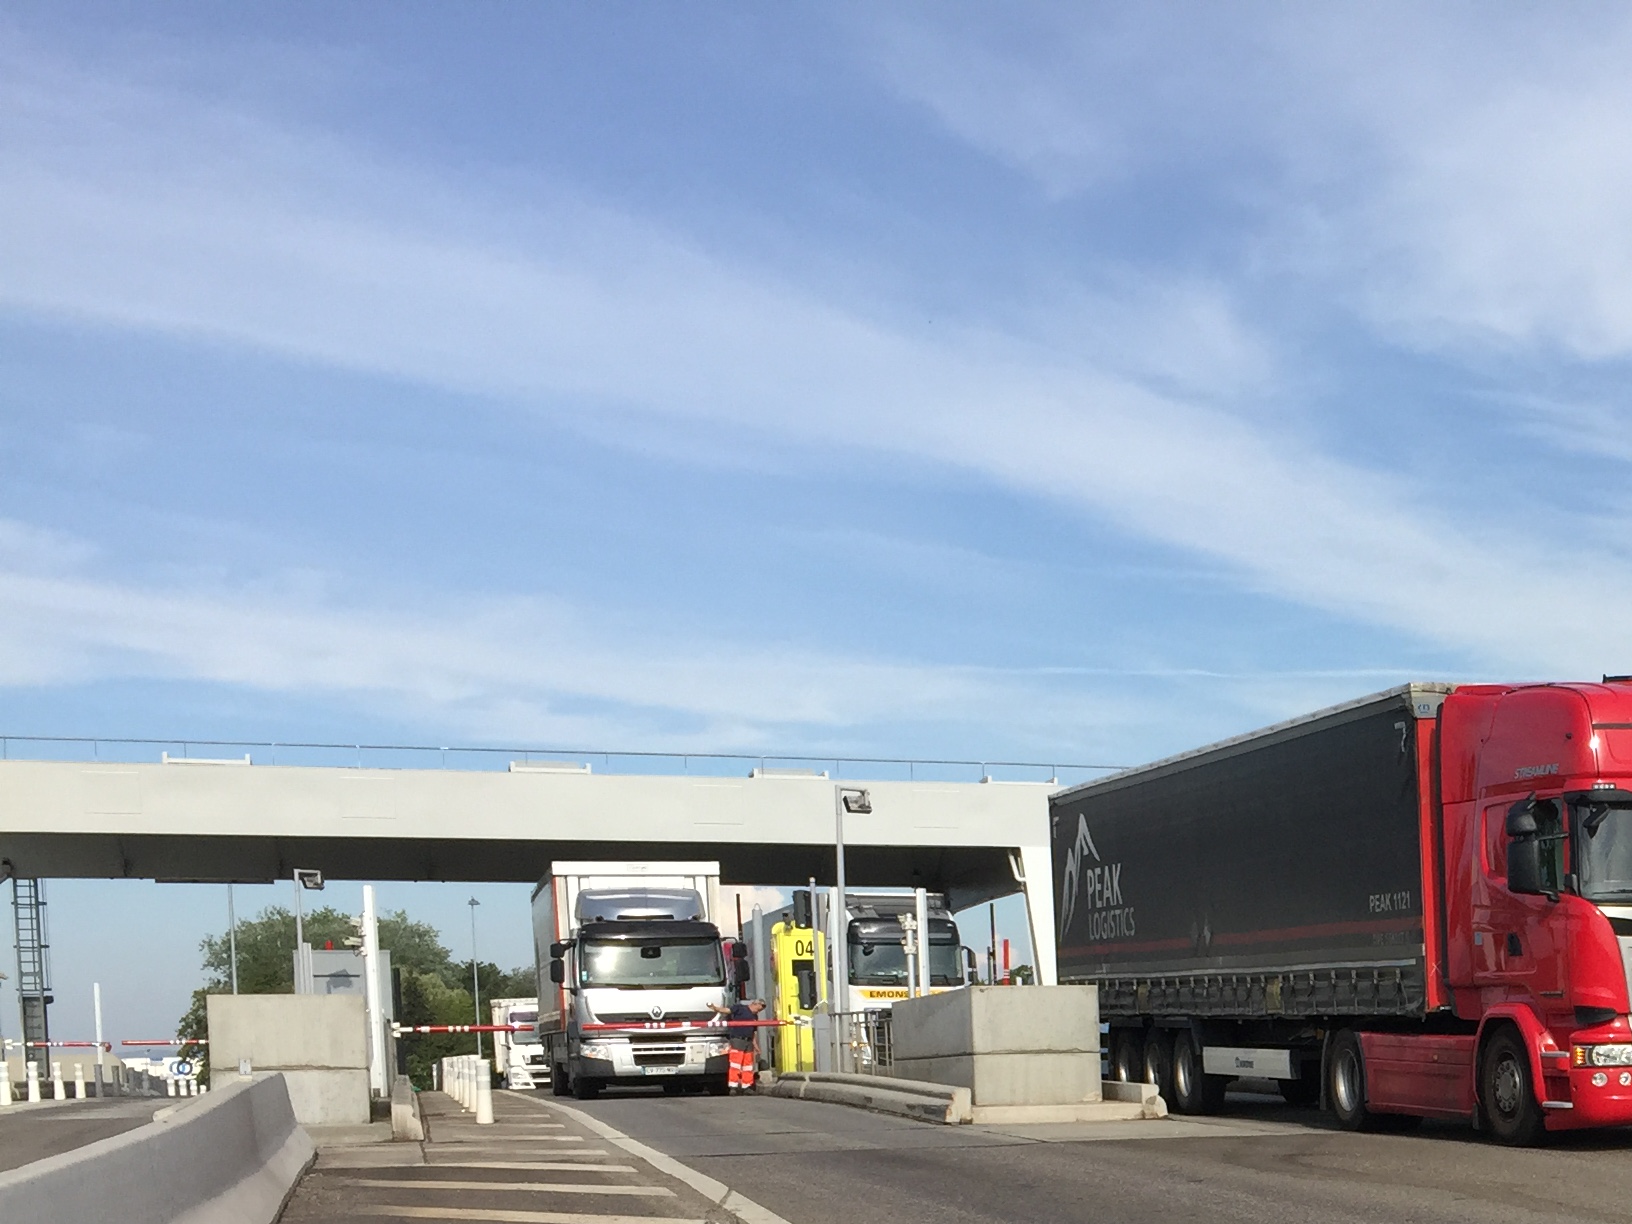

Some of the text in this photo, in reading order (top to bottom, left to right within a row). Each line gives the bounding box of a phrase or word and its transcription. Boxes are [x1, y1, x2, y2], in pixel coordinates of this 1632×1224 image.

[1086, 862, 1123, 909] PEAK
[1369, 890, 1411, 912] PEAK 1121
[1088, 906, 1135, 940] LOGISTICS
[795, 939, 814, 956] 04
